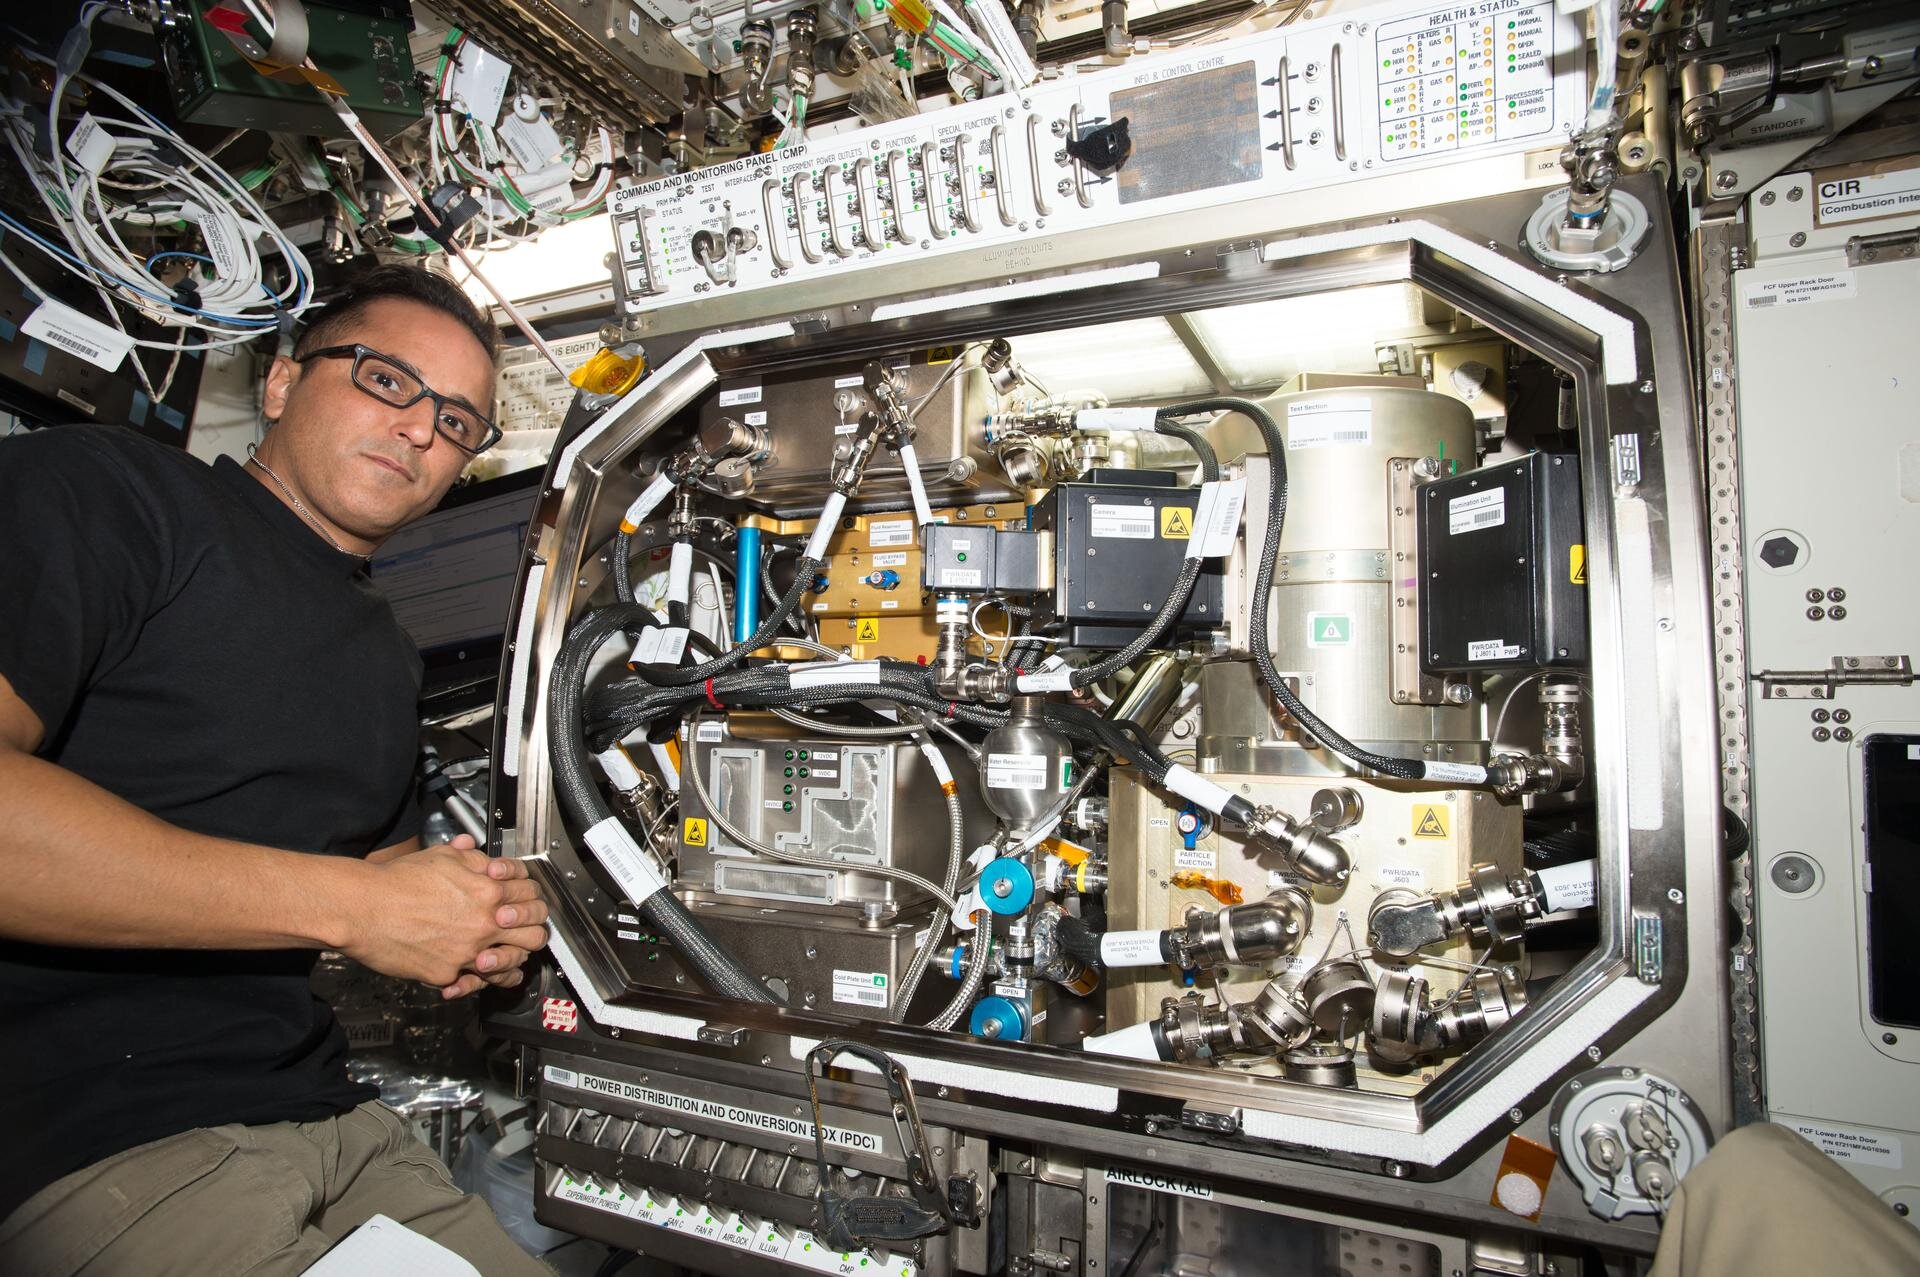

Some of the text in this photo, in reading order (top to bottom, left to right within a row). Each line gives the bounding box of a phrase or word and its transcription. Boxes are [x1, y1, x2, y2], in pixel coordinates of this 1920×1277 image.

[1429, 0, 1520, 26] HEALTH & STATUS
[1518, 17, 1542, 26] NORMAL
[1417, 30, 1440, 40] FILTERS
[1518, 28, 1542, 38] MANUAL
[1518, 40, 1534, 48] OPEN
[1518, 50, 1542, 59] SEALED
[1134, 55, 1225, 85] INFO & CONTROL CENTRE
[1727, 68, 1744, 78] TOP
[1505, 88, 1544, 101] PROCESSORS
[1519, 96, 1544, 107] RUNNING
[1519, 106, 1546, 117] STOPPED
[938, 115, 998, 136] SPECIAL FUNCTIONS
[1751, 117, 1806, 135] STANDOFF
[886, 135, 917, 149] FUNCTIONS
[783, 148, 864, 174] EXPERIMENT POWER OUTLETS
[1538, 162, 1554, 170] LOCK
[616, 144, 808, 201] COMMAND AND MONITORING PANEL (CMP)
[701, 174, 757, 193] TEST INTERFACES
[1821, 180, 1860, 198] CIR
[656, 198, 668, 208] PRIM
[1821, 198, 1895, 217] (Combustion
[662, 207, 683, 218] STATUS
[982, 242, 1053, 262] ILLUMINATION UNITS
[1005, 257, 1032, 270] BEHIND
[1778, 281, 1798, 289] Upper
[565, 341, 596, 355] EIGHTY
[1451, 499, 1479, 510] Illumination
[1093, 508, 1116, 516] Camera
[1180, 851, 1211, 859] PARTICLE
[1178, 859, 1213, 868] INJECTION
[1382, 869, 1420, 877] PWR/DATA
[1002, 988, 1019, 996] OPEN
[584, 1076, 621, 1095] POWER
[624, 1086, 699, 1112] DISTRIBUTION
[701, 1103, 725, 1118] AND
[728, 1108, 807, 1136] CONVERSION
[840, 1131, 876, 1150] (PDC)
[1815, 1129, 1837, 1138] Lower
[1839, 1133, 1857, 1141] Rack
[1859, 1136, 1877, 1144] Door
[1824, 1148, 1835, 1156] S/N
[1107, 1166, 1211, 1196] AIRLOCK (AL)
[565, 1189, 622, 1211] EXPERIMENT POWERS
[637, 1209, 649, 1219] FAN
[667, 1217, 684, 1229] FAN C
[694, 1225, 713, 1237] FAN R
[722, 1232, 749, 1247] AIRLOCK
[759, 1242, 779, 1256] ILLUM.
[839, 1263, 855, 1274] CMP
[902, 1259, 915, 1267] +5V
